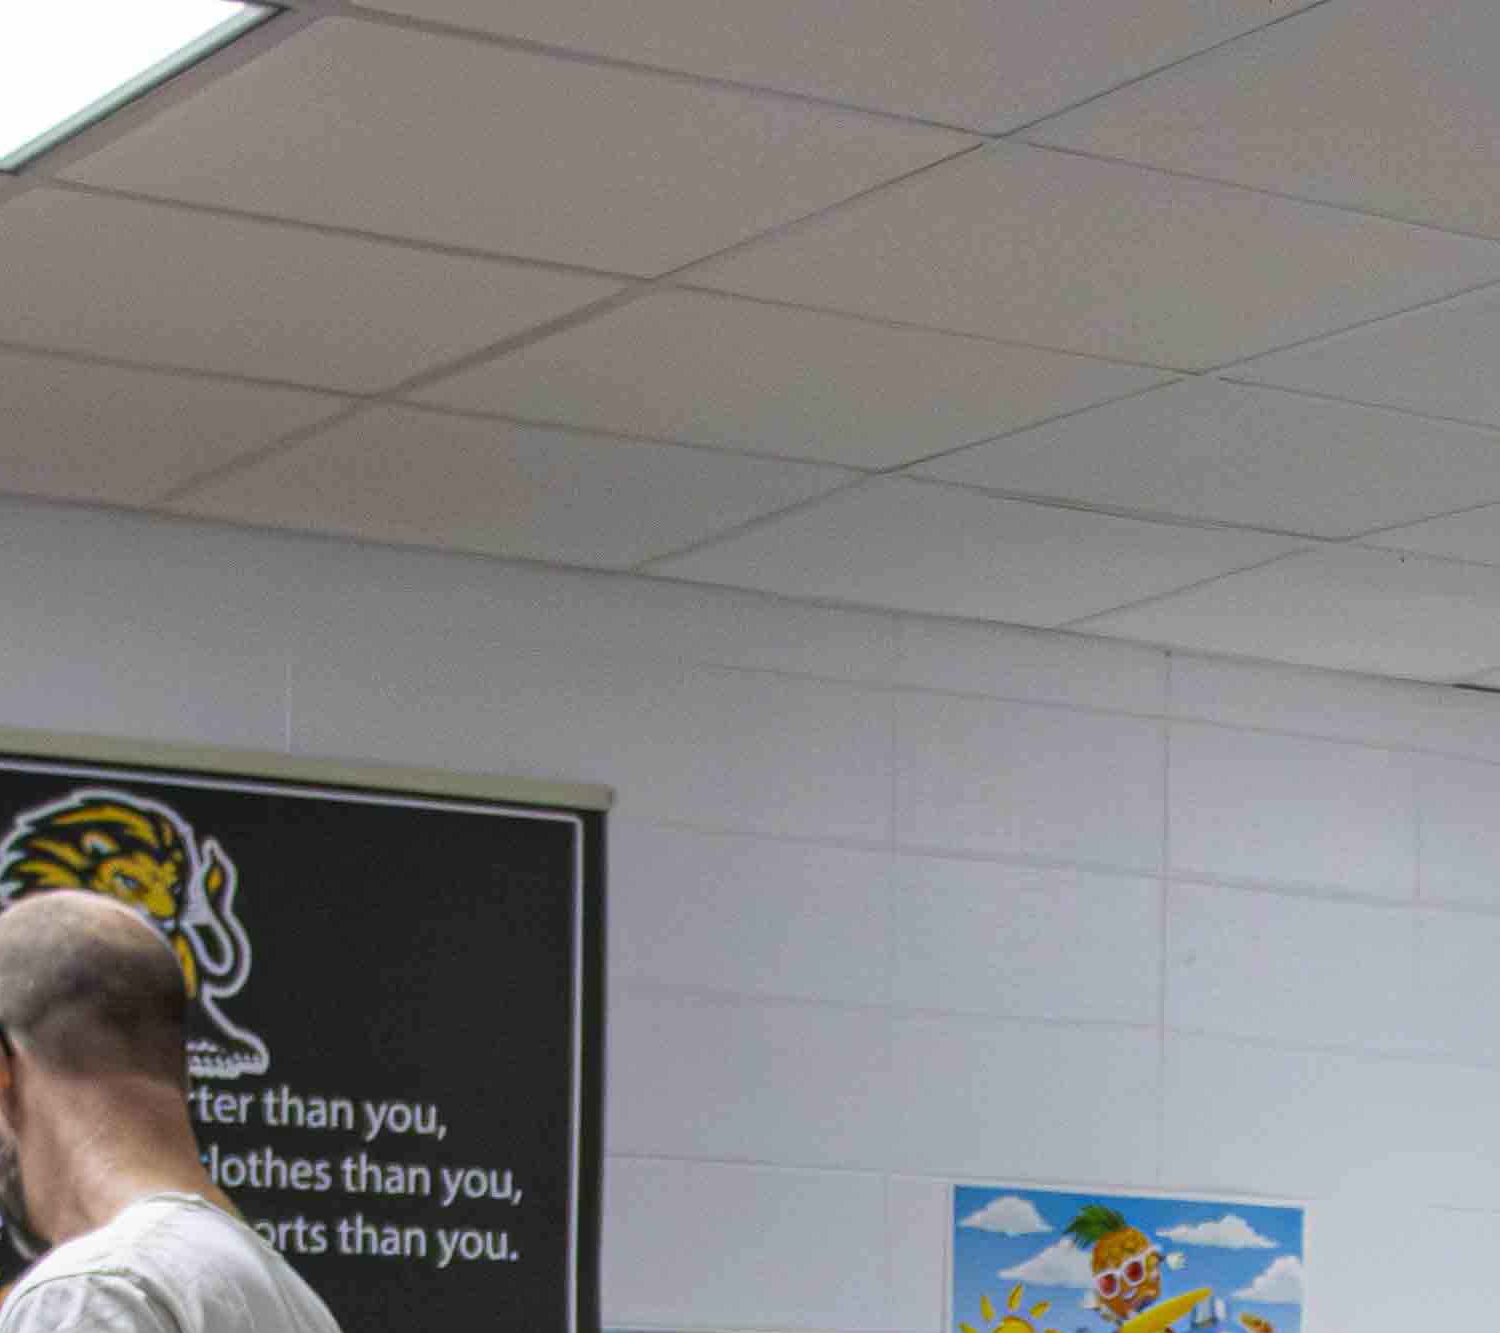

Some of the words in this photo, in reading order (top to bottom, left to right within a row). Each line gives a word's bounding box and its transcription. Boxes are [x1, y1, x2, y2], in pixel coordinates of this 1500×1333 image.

[262, 1085, 353, 1129] than
[362, 1100, 447, 1142] you,
[204, 1144, 332, 1191] lothes
[341, 1152, 431, 1195] than
[440, 1167, 523, 1206] you,
[253, 1215, 328, 1253] orts
[337, 1213, 427, 1257] than
[436, 1227, 519, 1268] you.
